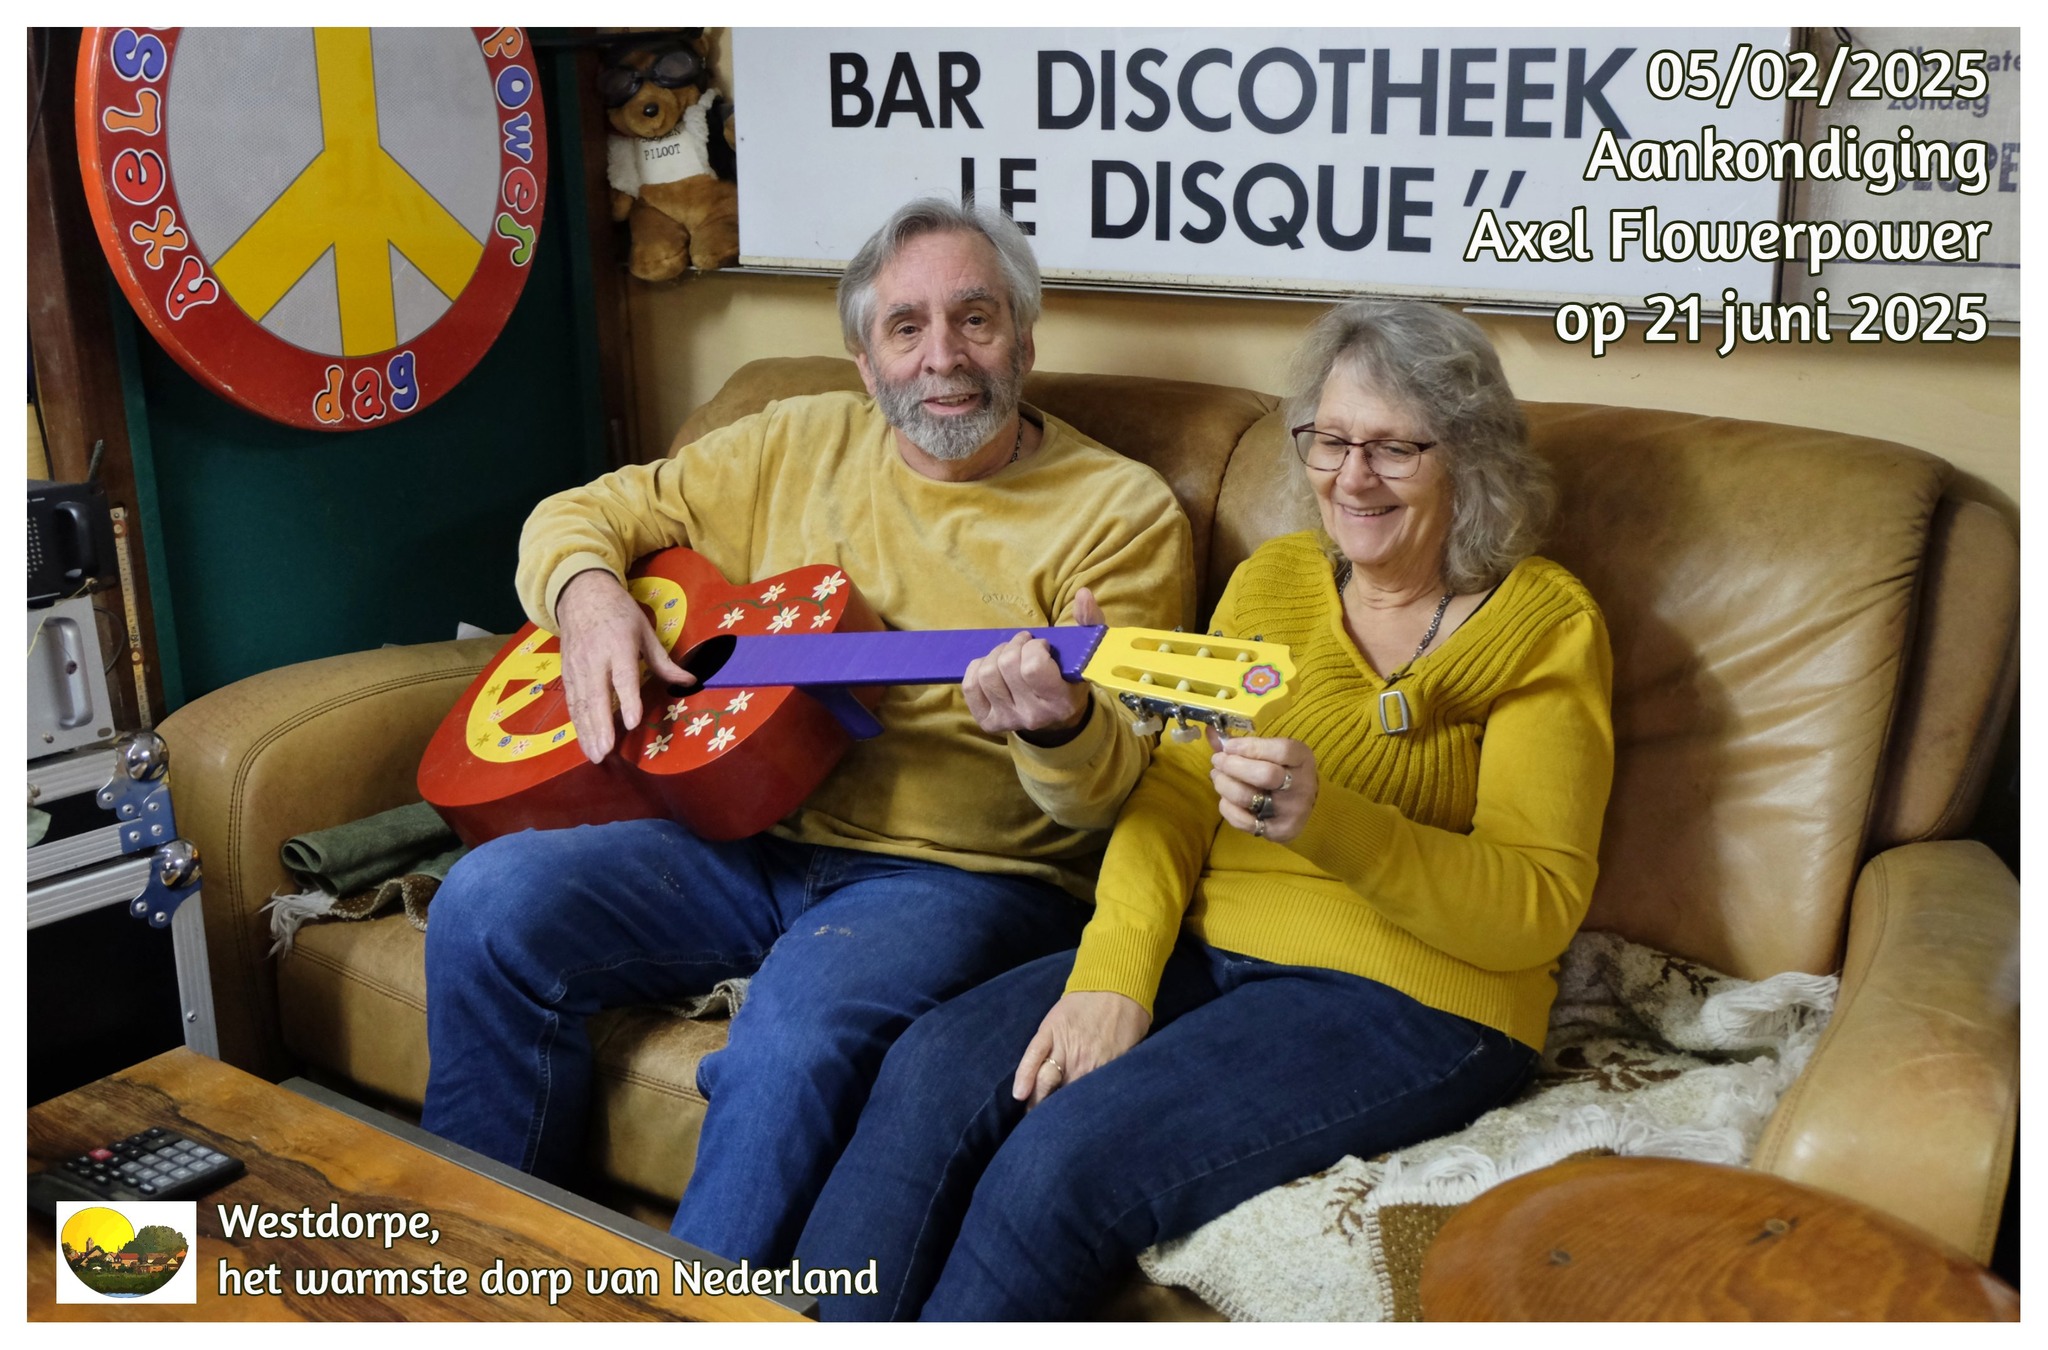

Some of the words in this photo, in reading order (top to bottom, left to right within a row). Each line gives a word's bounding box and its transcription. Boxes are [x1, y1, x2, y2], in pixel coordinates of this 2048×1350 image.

[829, 51, 984, 129] BAR
[1037, 47, 1638, 140] DISCOTHEEK
[644, 143, 681, 160] PILOOT
[313, 350, 420, 423] dag
